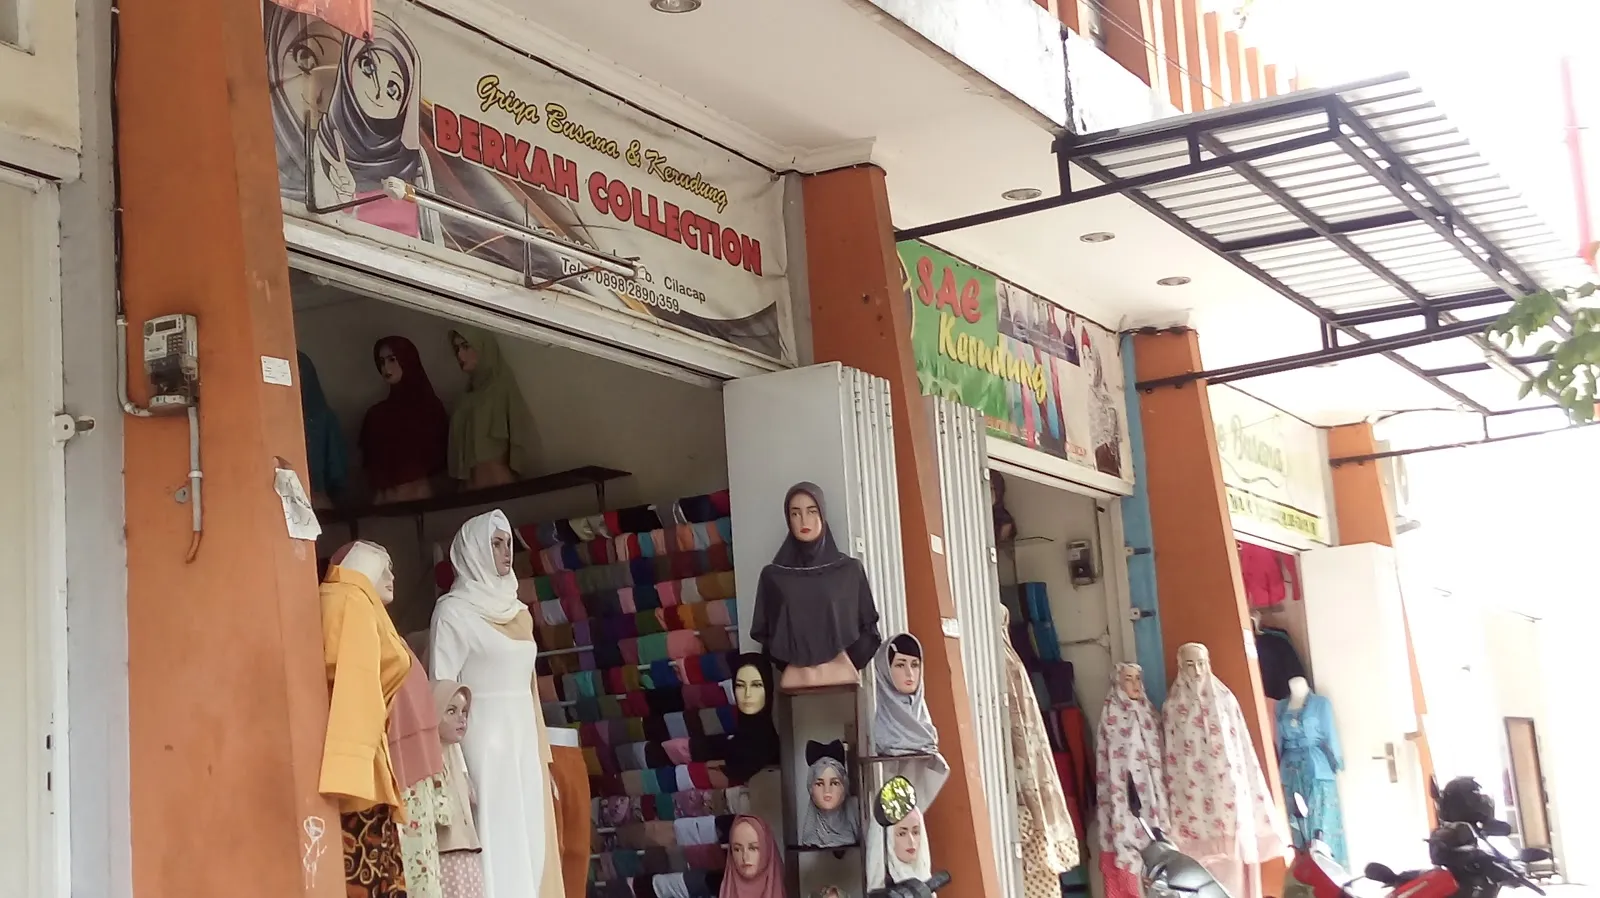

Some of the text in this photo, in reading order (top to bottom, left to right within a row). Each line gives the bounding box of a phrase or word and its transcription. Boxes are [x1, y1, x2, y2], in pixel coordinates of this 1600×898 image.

[433, 103, 763, 277] BERKAH COLLECTION
[476, 74, 730, 214] Griya Busana & Kerudung
[664, 276, 706, 304] Cilacap
[938, 311, 1048, 405] Kerudung
